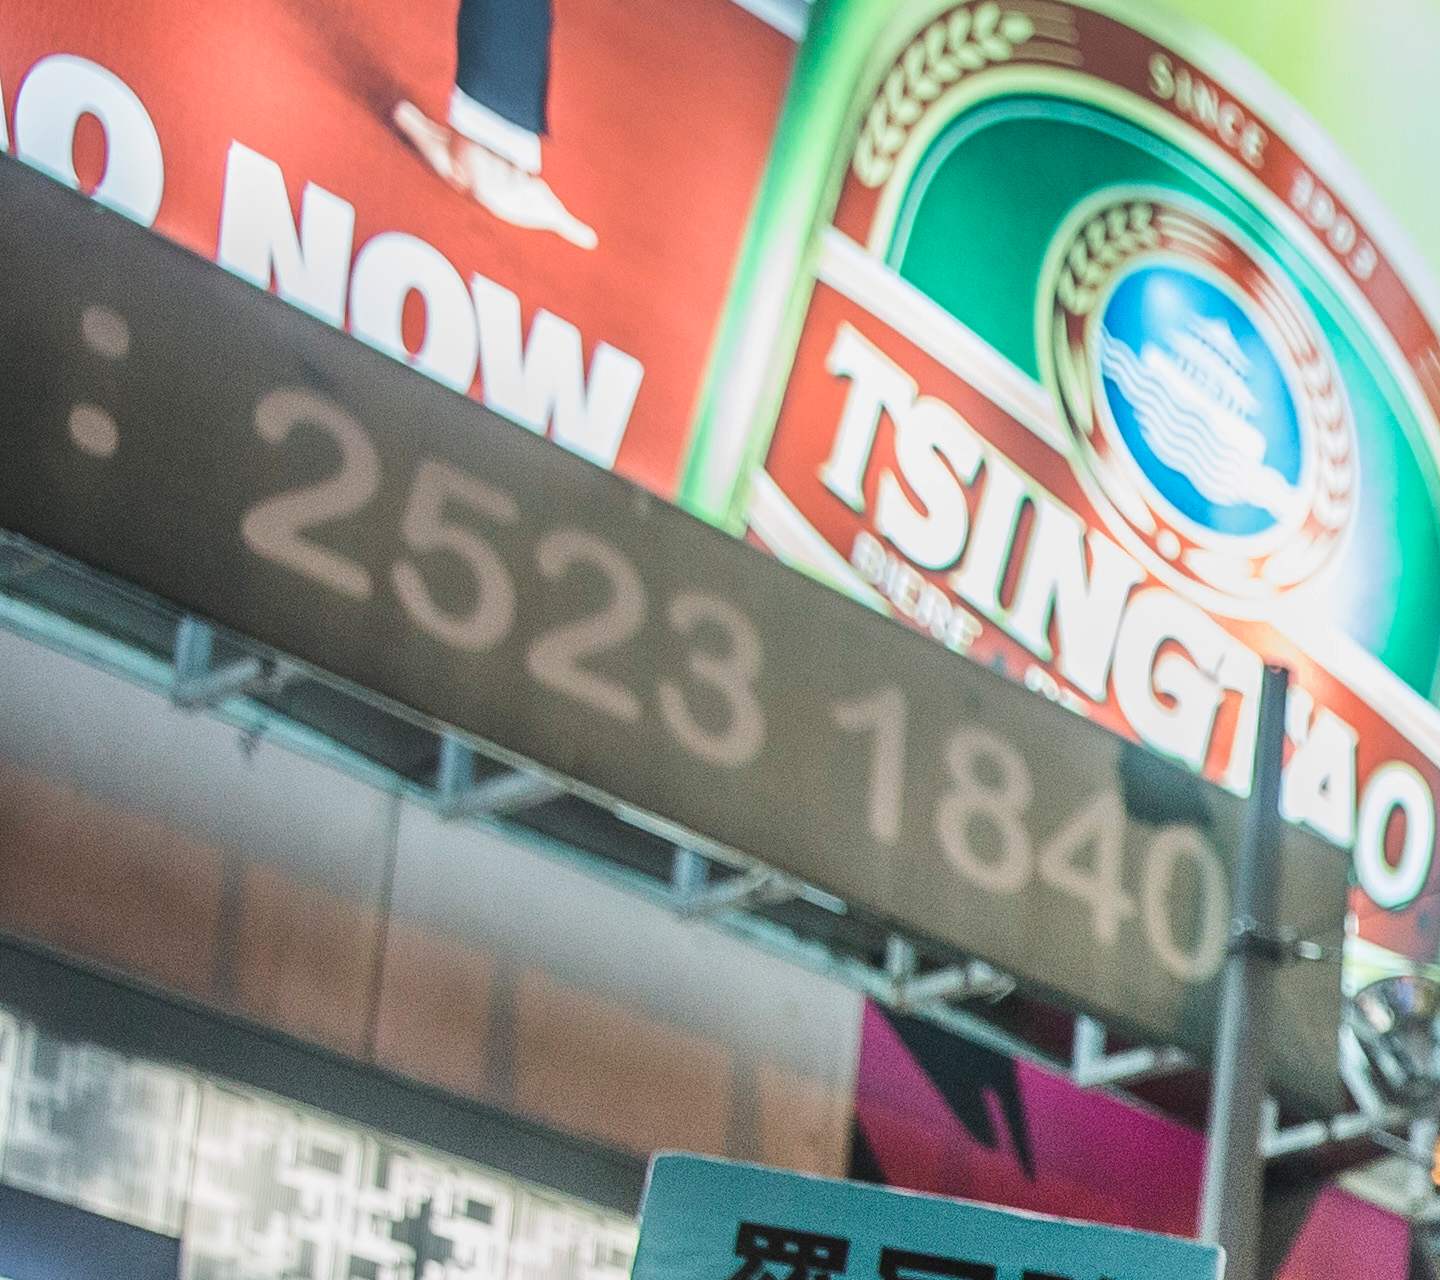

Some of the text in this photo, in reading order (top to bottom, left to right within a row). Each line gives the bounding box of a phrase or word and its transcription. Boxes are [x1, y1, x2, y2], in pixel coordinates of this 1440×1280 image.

[0, 53, 645, 470] O NOW
[1148, 53, 1269, 169] SINCE
[240, 388, 765, 769] 2523
[831, 685, 1231, 984] 1840
[819, 322, 1434, 909] TSINGTAO
